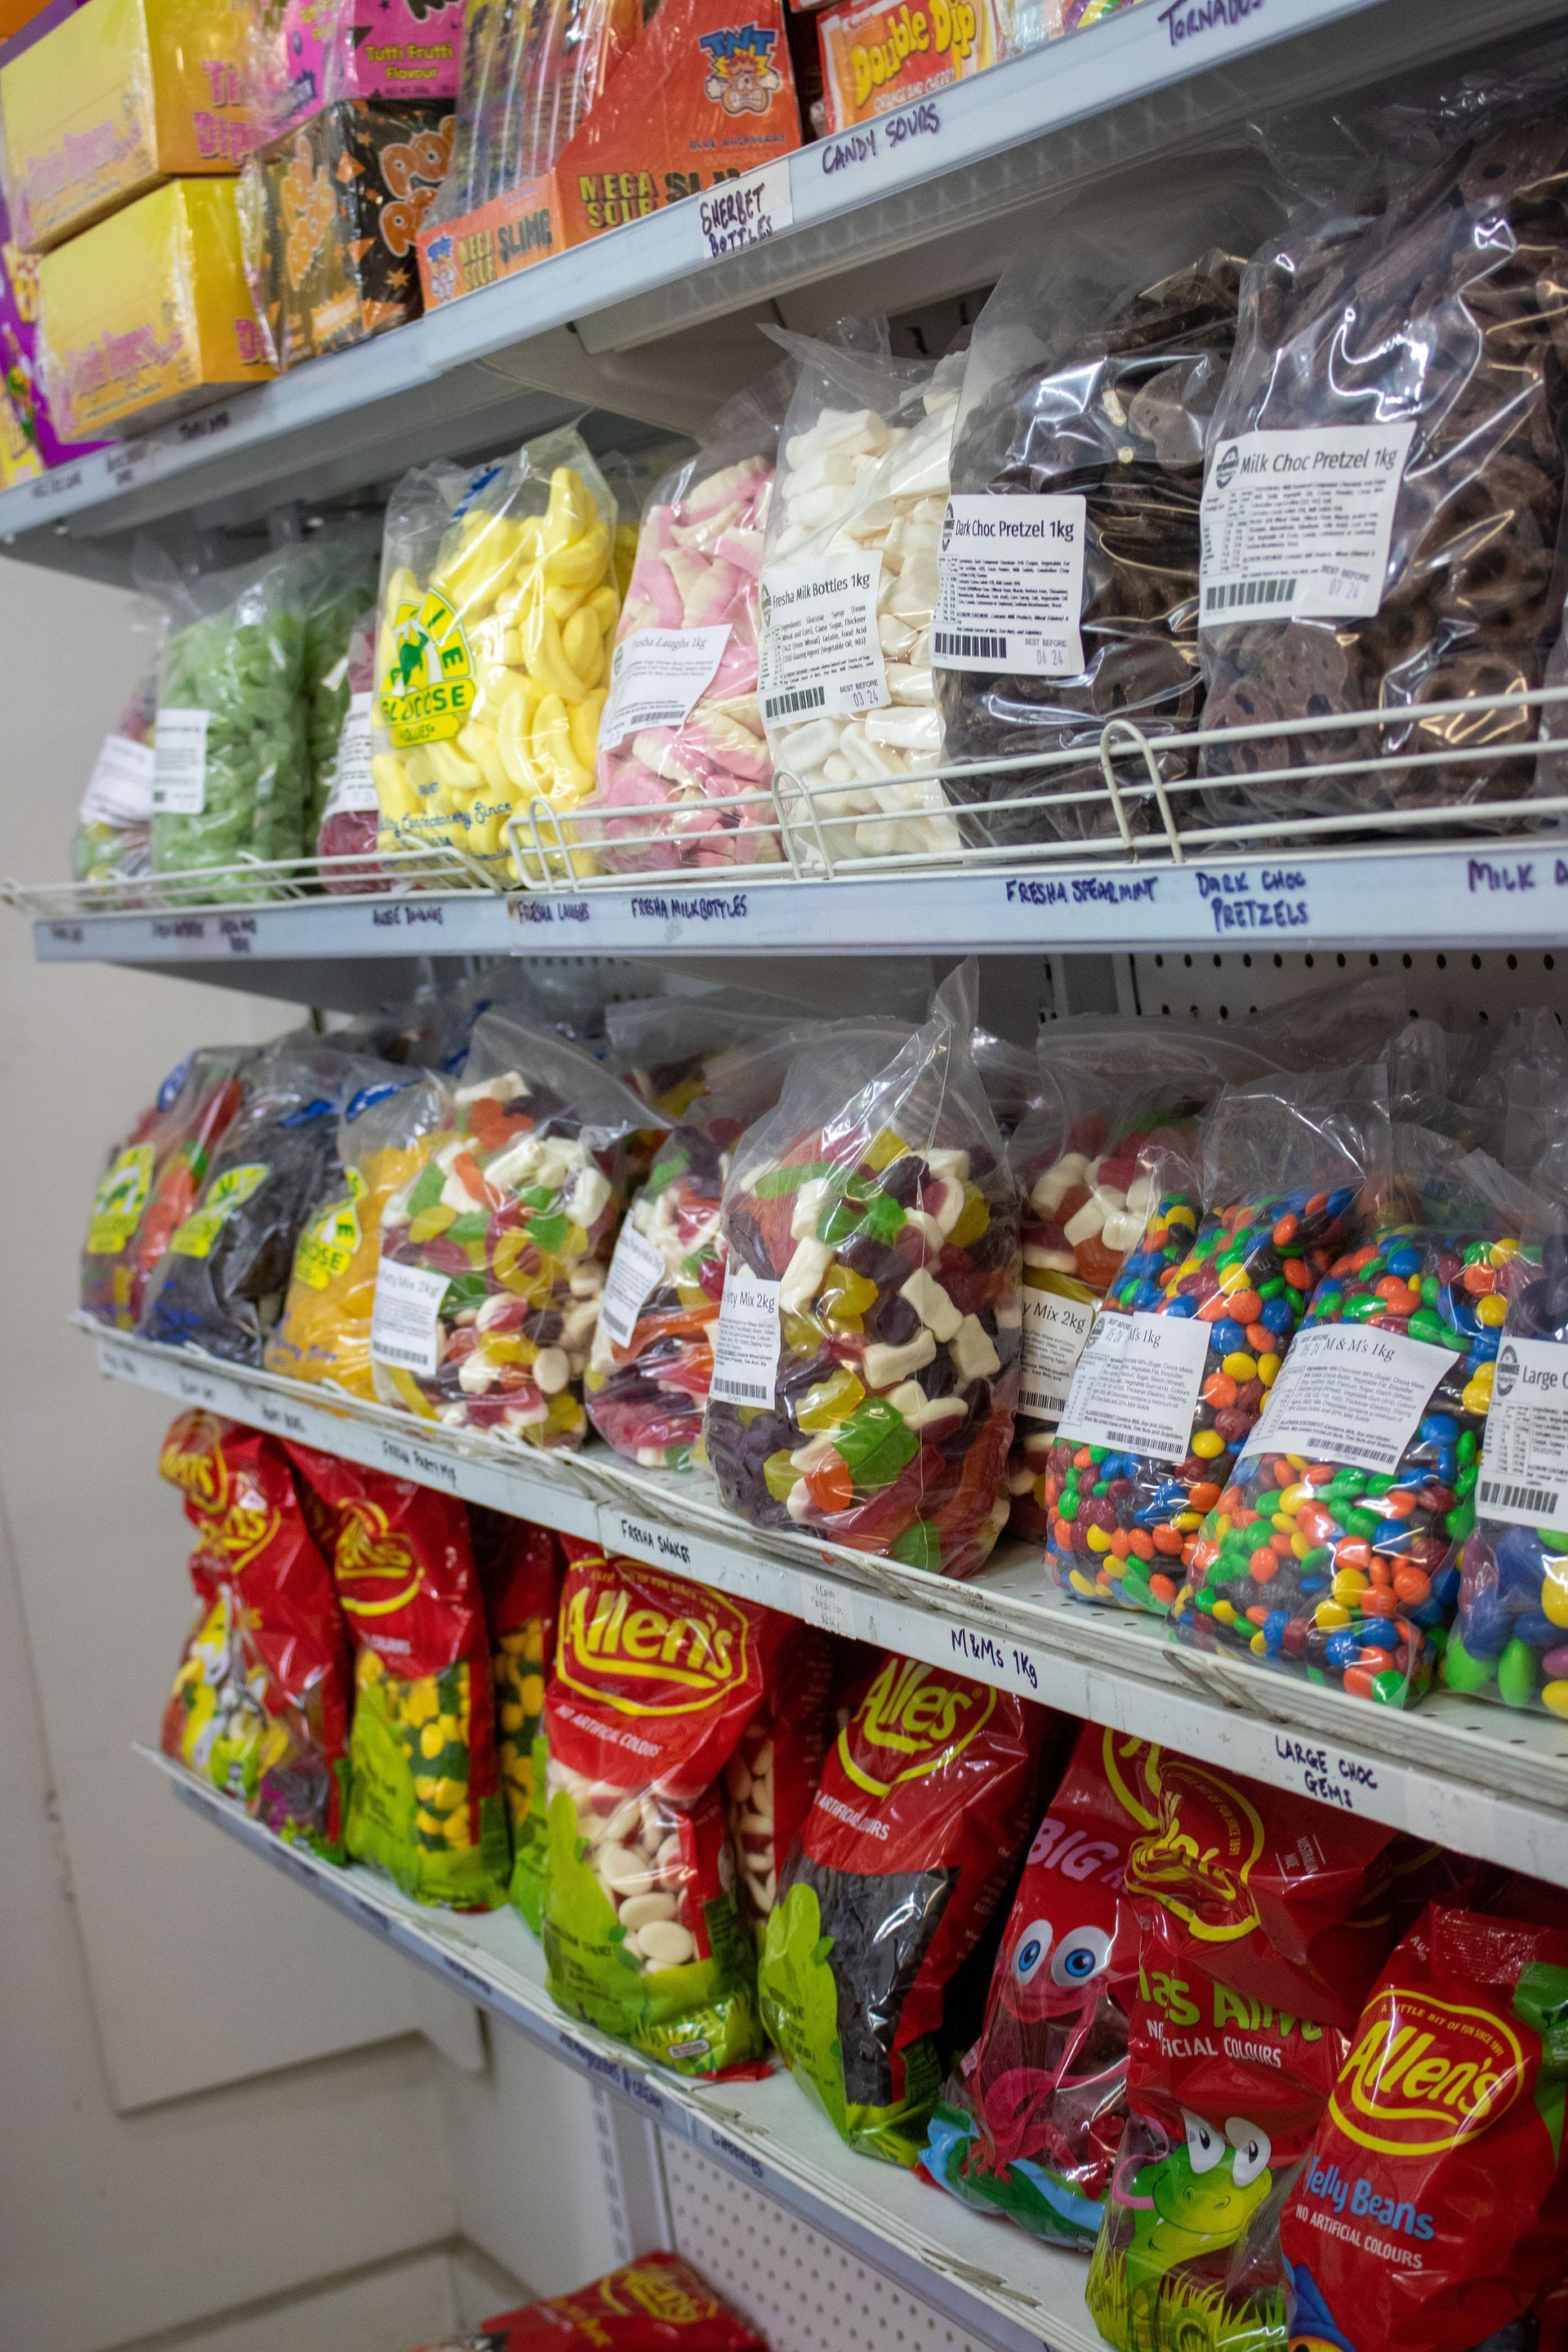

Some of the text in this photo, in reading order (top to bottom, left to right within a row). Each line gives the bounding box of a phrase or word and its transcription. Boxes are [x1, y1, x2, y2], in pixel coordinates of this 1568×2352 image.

[365, 43, 454, 62] Tutti Frutti
[699, 24, 777, 59] TNT
[851, 0, 977, 108] Double Dip
[822, 103, 941, 175] CANDY SOURS
[707, 215, 773, 259] BOTTLES
[1241, 448, 1398, 475] Milk Choc Pretzel 1kg
[955, 519, 1075, 542] Dark Choc Pretzel 1kg
[1321, 564, 1370, 583] BEST BEFORE
[773, 572, 871, 608] Fresha Milk Bottles 1kg
[655, 637, 707, 652] Laughs 1kg
[1024, 637, 1068, 648] BEST BEFORE
[840, 678, 879, 693] BEST BEFORE
[1195, 869, 1307, 898] DARK CHOC
[1468, 858, 1536, 893] MILK
[630, 896, 668, 920] FRESHA
[1005, 879, 1068, 905] FRESHA
[1210, 896, 1308, 933] PRETZELS
[739, 1290, 755, 1307] Mix
[756, 1292, 776, 1314] 2kg
[1033, 1302, 1059, 1322] Mix
[1061, 1310, 1087, 1334] 2kg
[1143, 1329, 1161, 1349] 1kg
[1335, 1337, 1347, 1351] &
[1348, 1339, 1369, 1353] M's
[1371, 1343, 1396, 1363] 1kg
[1521, 1365, 1558, 1392] Large
[620, 1519, 654, 1549] FRESHA
[564, 1585, 734, 1682] Allen's
[1276, 1735, 1379, 1791] LARGE CHOC
[1303, 1769, 1355, 1810] GEMS
[1026, 1817, 1120, 1882] BIG
[1223, 2036, 1282, 2069] COLOURS
[1337, 2020, 1503, 2118] Allen's
[1350, 2177, 1436, 2241] Beans
[1295, 2203, 1423, 2270] NO ARTIFICIAL COLOURS
